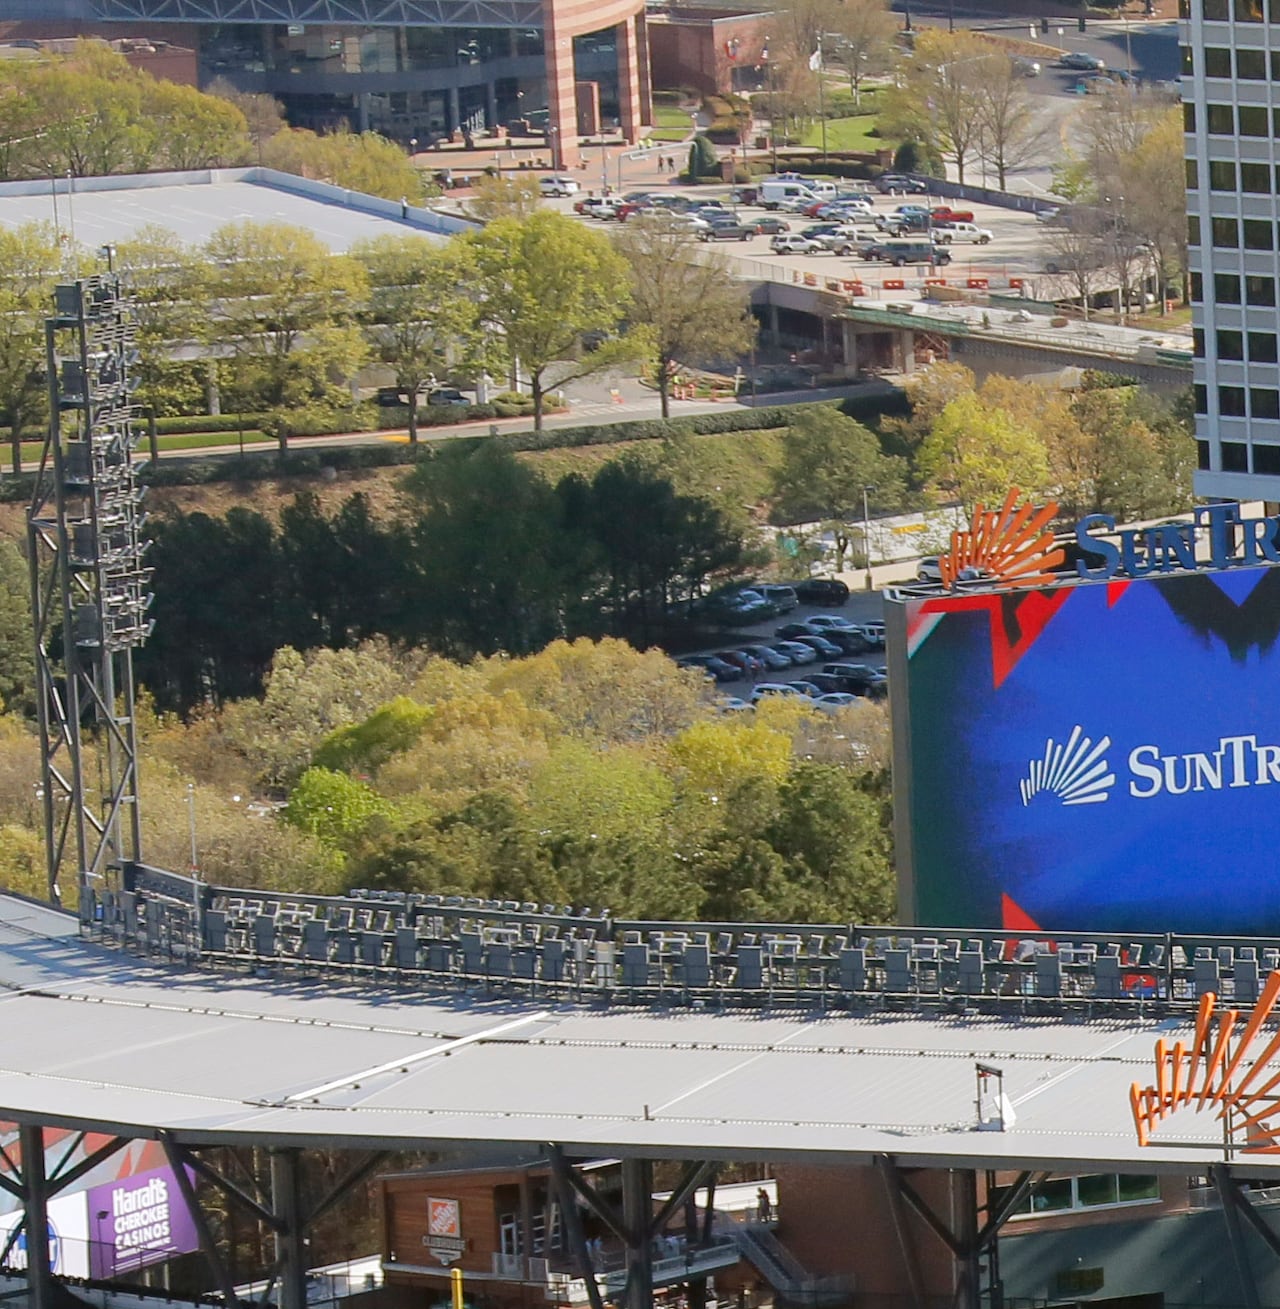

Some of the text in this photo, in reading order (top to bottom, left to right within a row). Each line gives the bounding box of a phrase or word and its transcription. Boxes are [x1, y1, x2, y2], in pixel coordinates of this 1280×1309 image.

[112, 1177, 168, 1217] Harrah's
[114, 1204, 169, 1234] CHEROKEE
[115, 1221, 171, 1251] CASINOS
